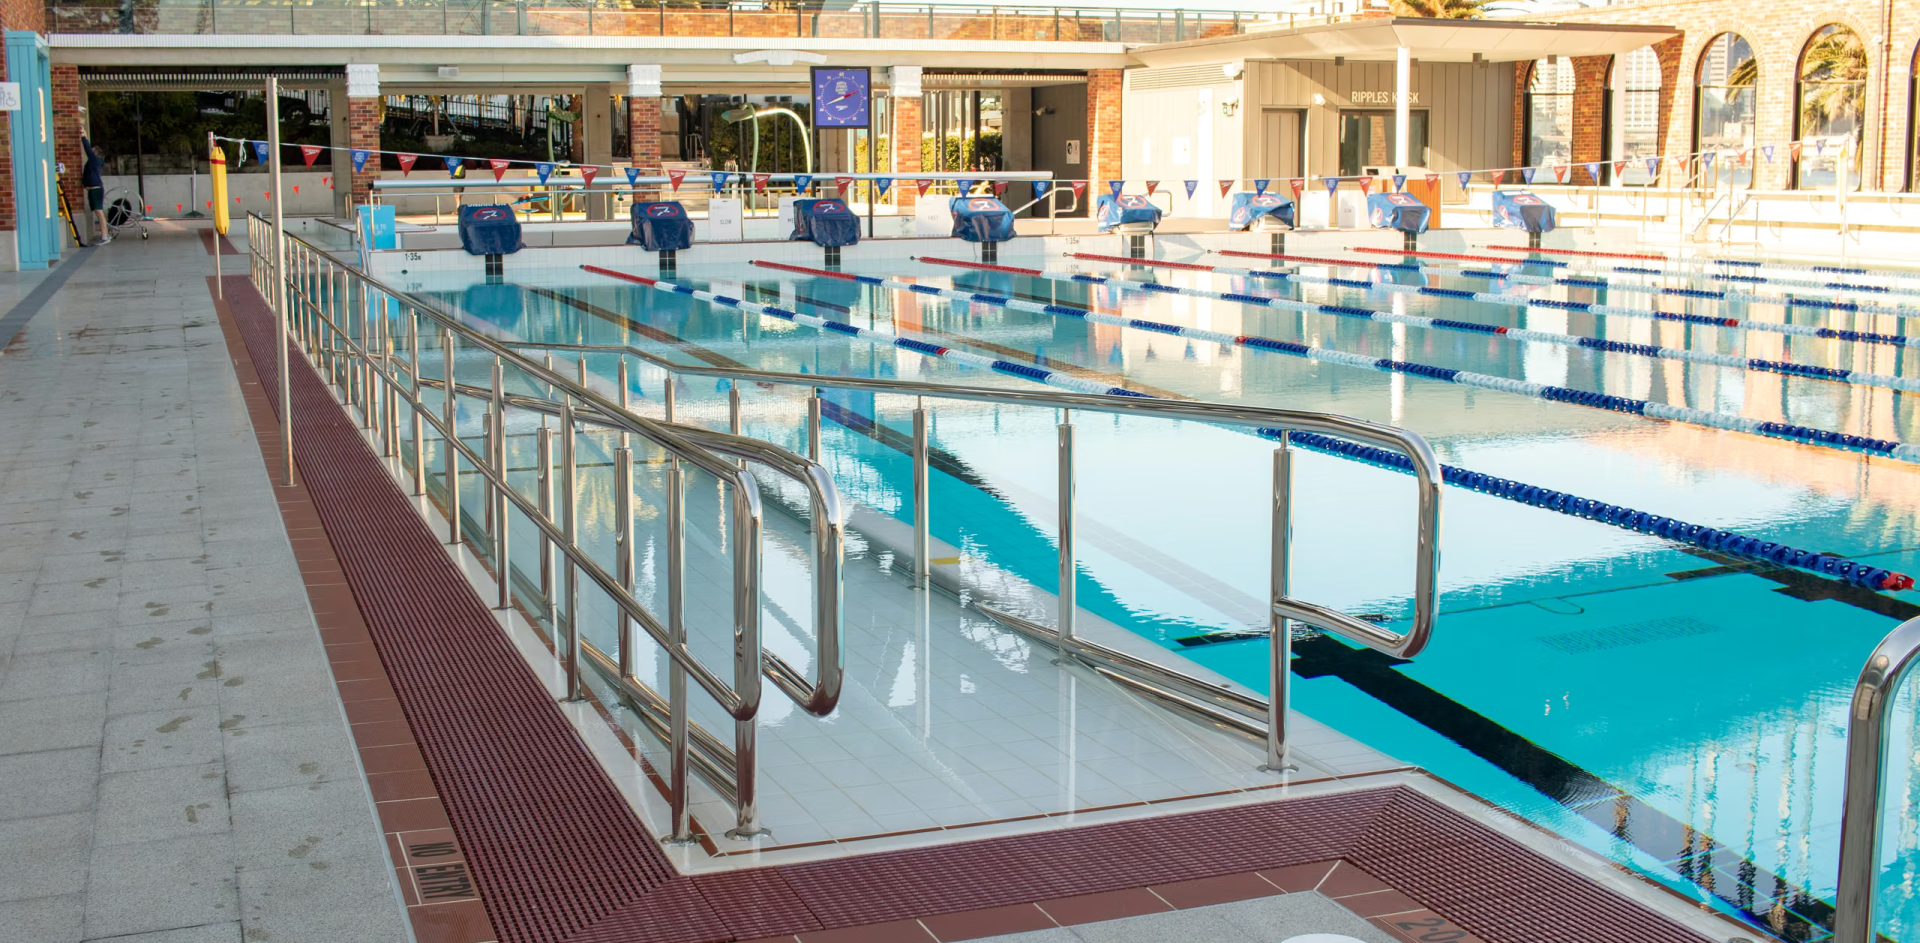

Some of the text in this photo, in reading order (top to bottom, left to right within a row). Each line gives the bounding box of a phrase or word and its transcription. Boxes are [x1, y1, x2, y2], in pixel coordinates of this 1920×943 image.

[1351, 91, 1419, 104] RIPPLES KSK
[409, 841, 475, 899] NO ENTRY
